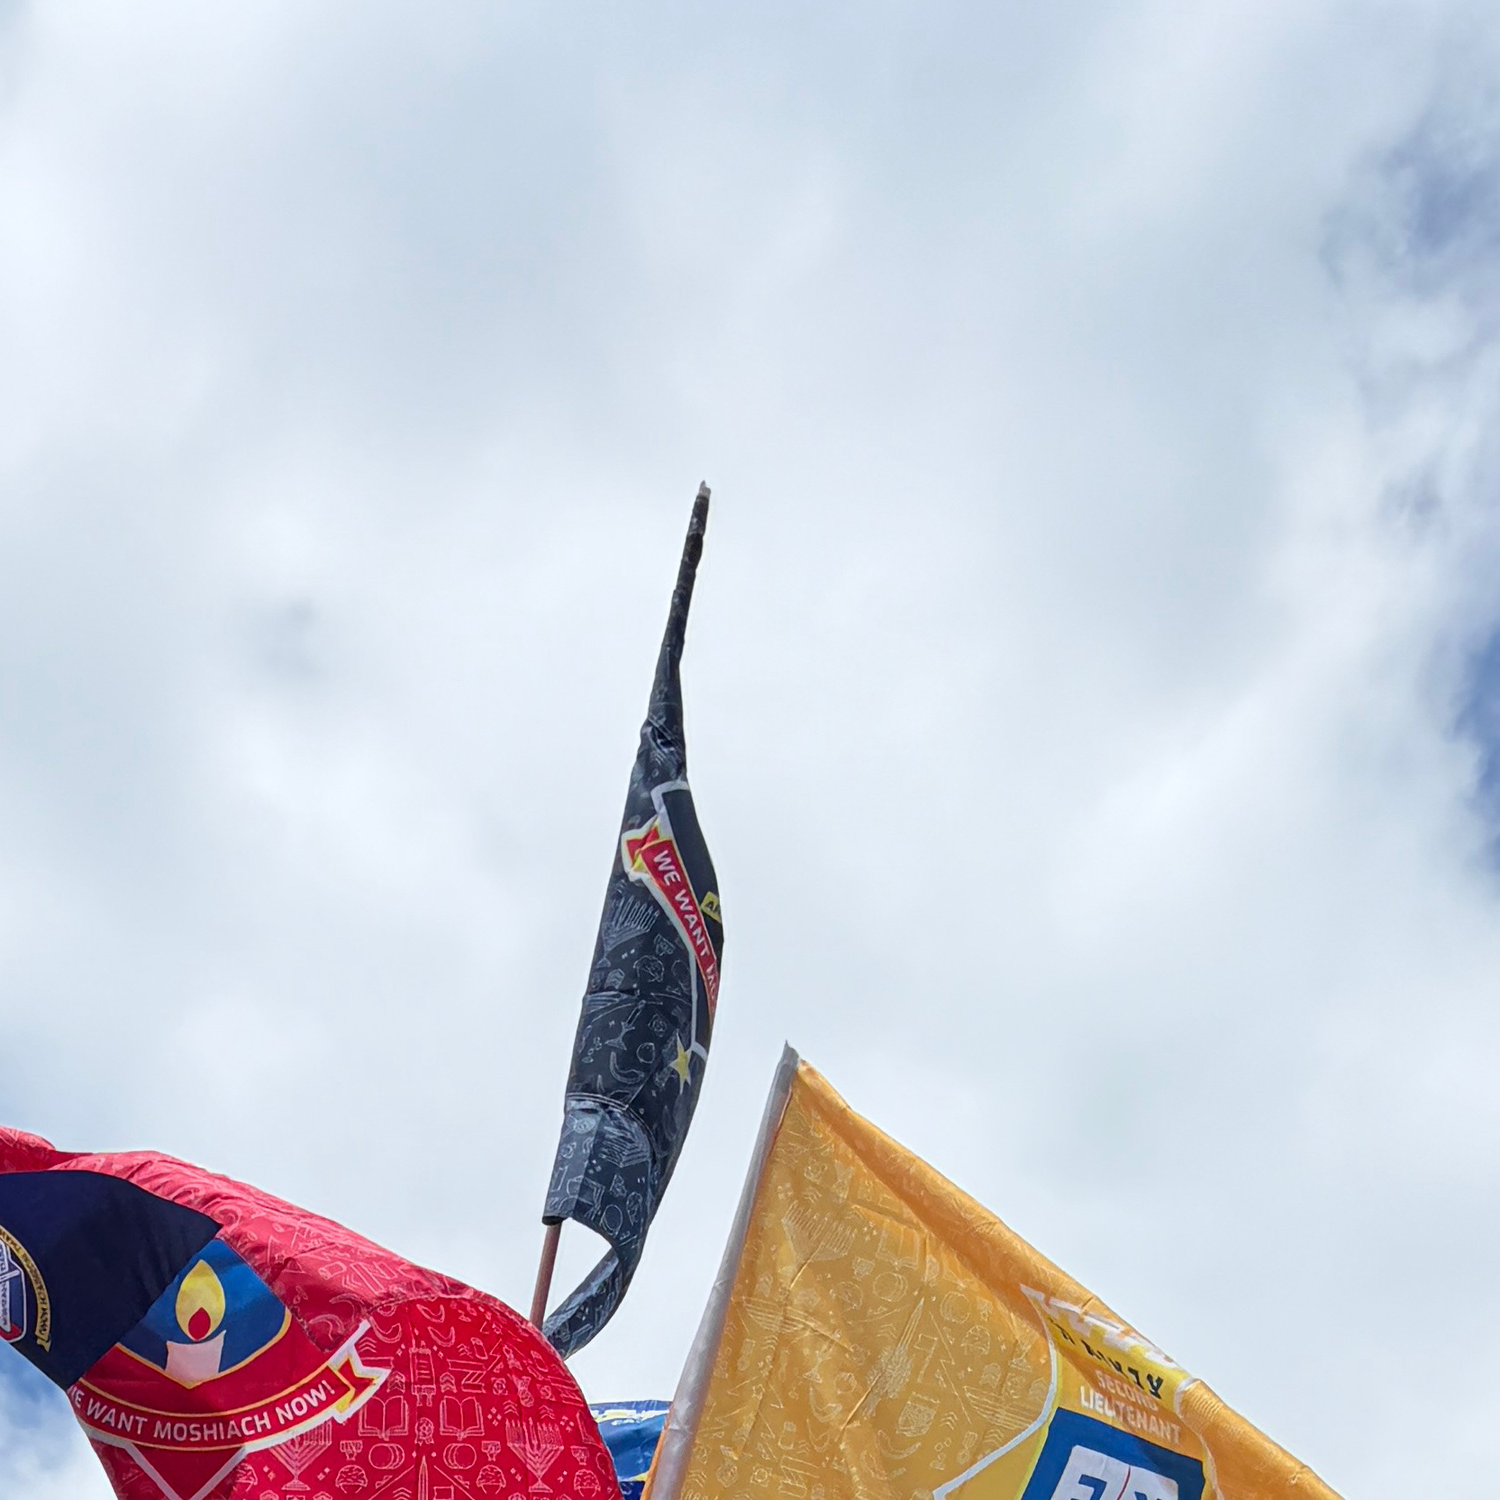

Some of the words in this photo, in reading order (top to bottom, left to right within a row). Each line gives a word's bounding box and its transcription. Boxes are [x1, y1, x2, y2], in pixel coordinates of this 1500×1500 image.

[653, 849, 681, 886] WE
[674, 889, 710, 957] WANT
[86, 1398, 148, 1435] WANT
[153, 1411, 271, 1442] MOSHIACH
[275, 1379, 336, 1425] NOW!
[1079, 1385, 1182, 1444] LIEUTENANT
[1095, 1369, 1159, 1411] SECOND
